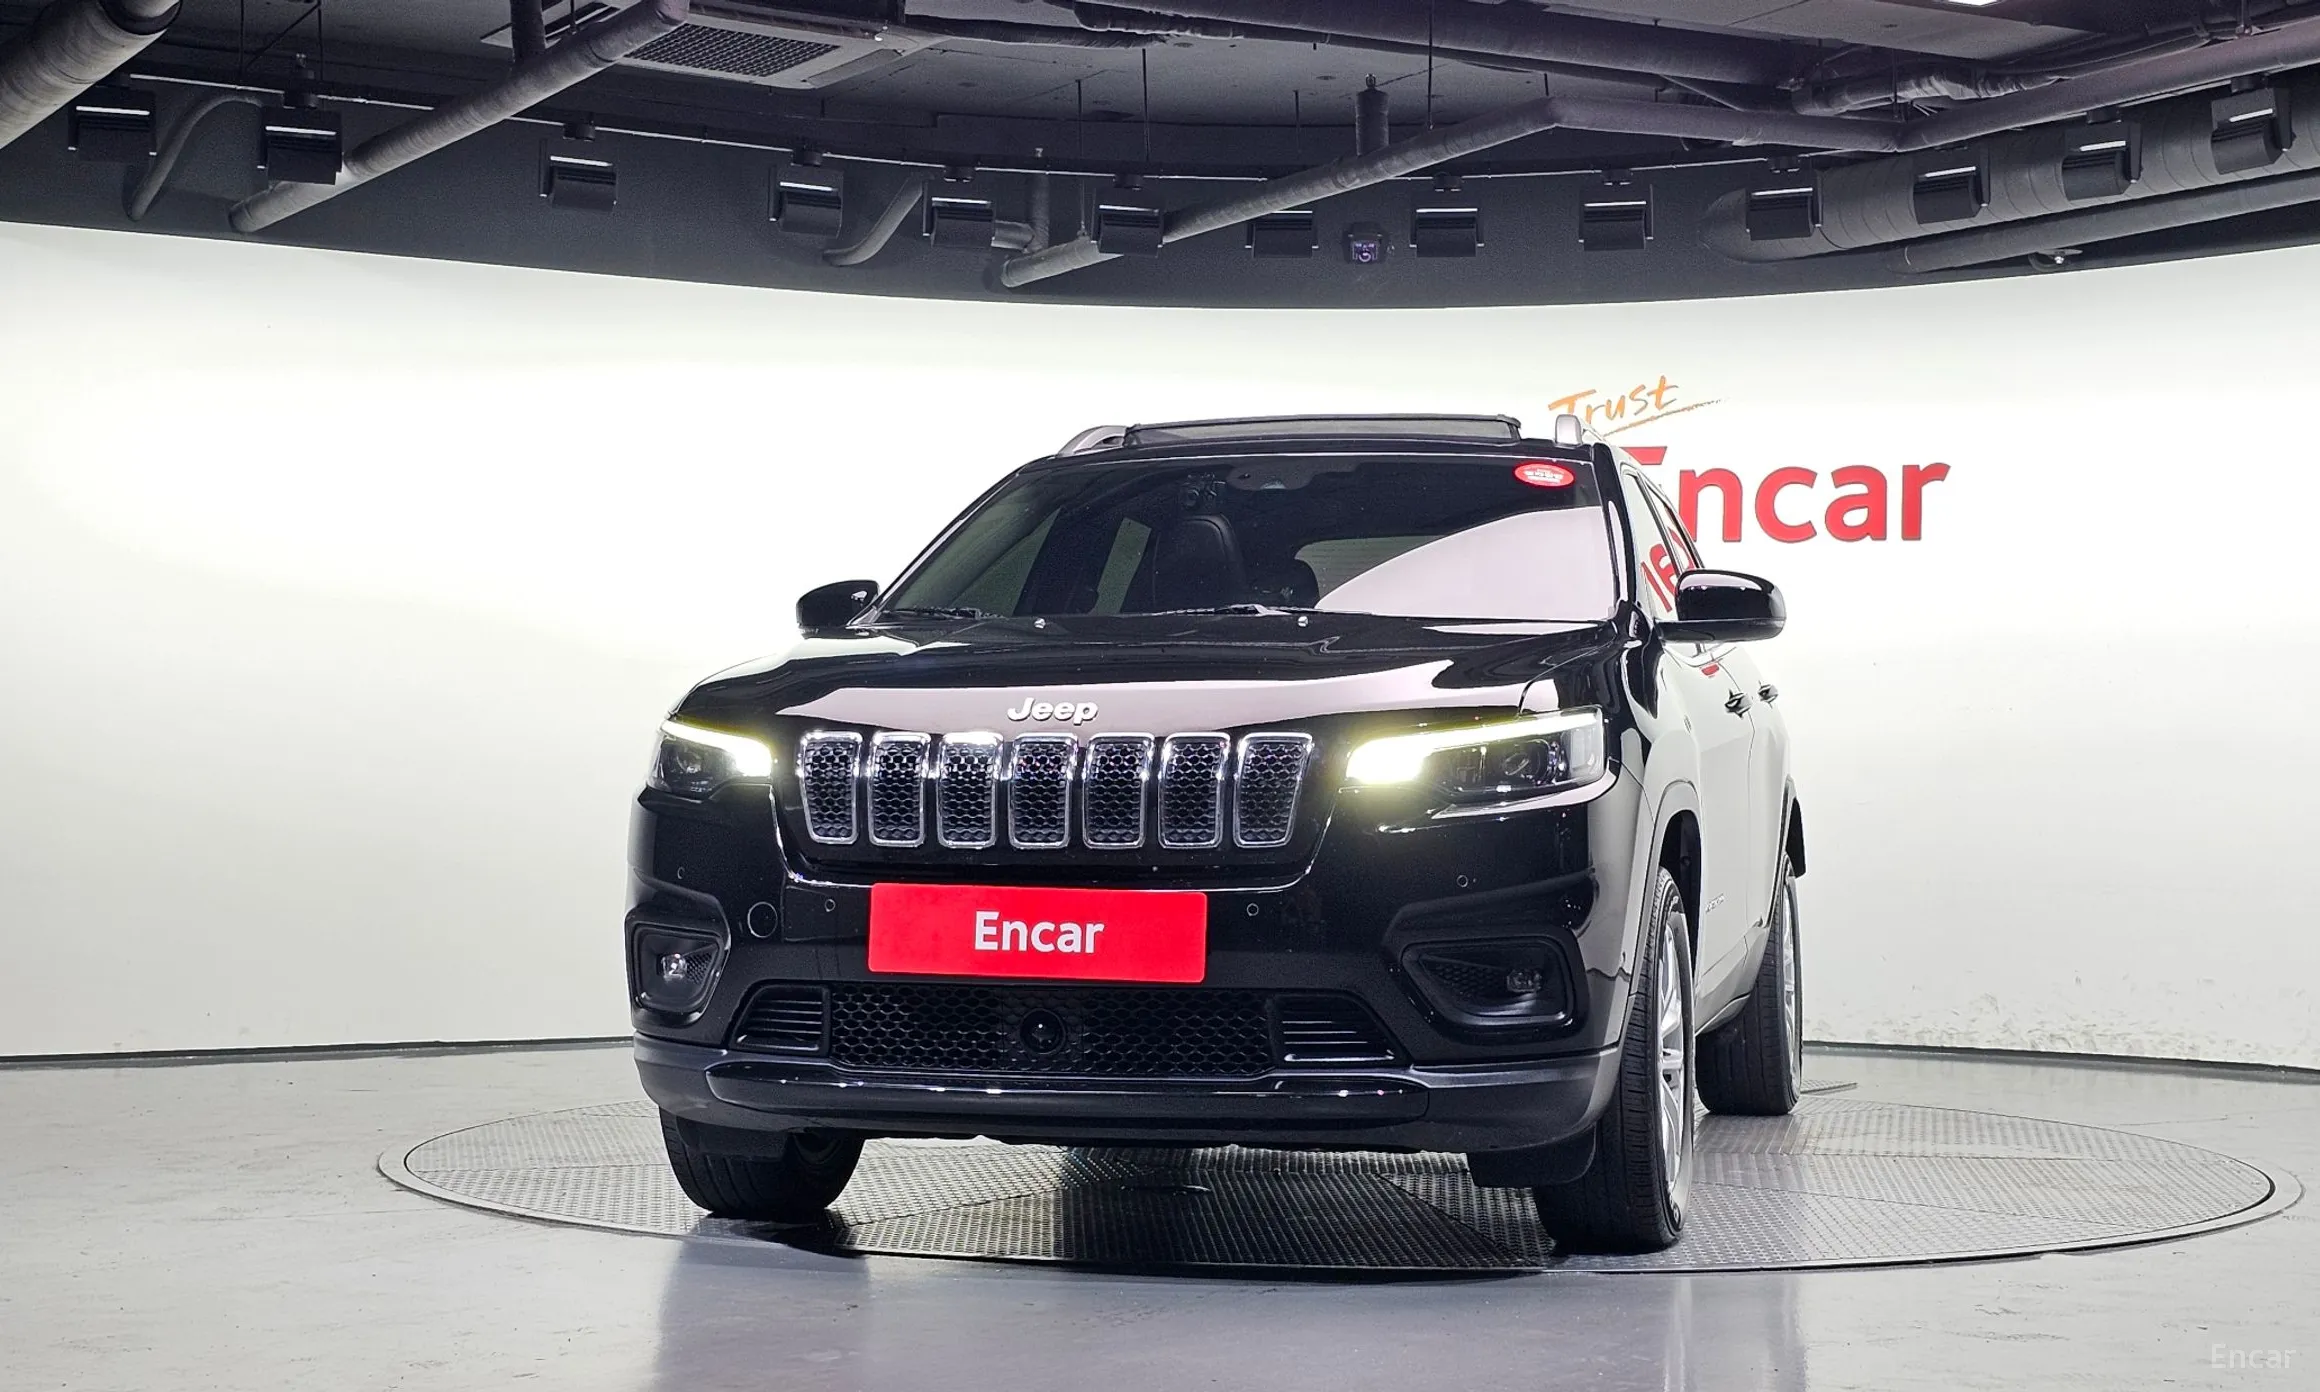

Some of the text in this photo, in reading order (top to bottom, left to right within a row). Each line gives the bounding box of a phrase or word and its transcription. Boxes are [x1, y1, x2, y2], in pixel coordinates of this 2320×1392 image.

[1548, 375, 1679, 425] Trust
[1620, 446, 1951, 544] ncar
[1007, 697, 1099, 726] Jeep
[973, 910, 1105, 954] Encar
